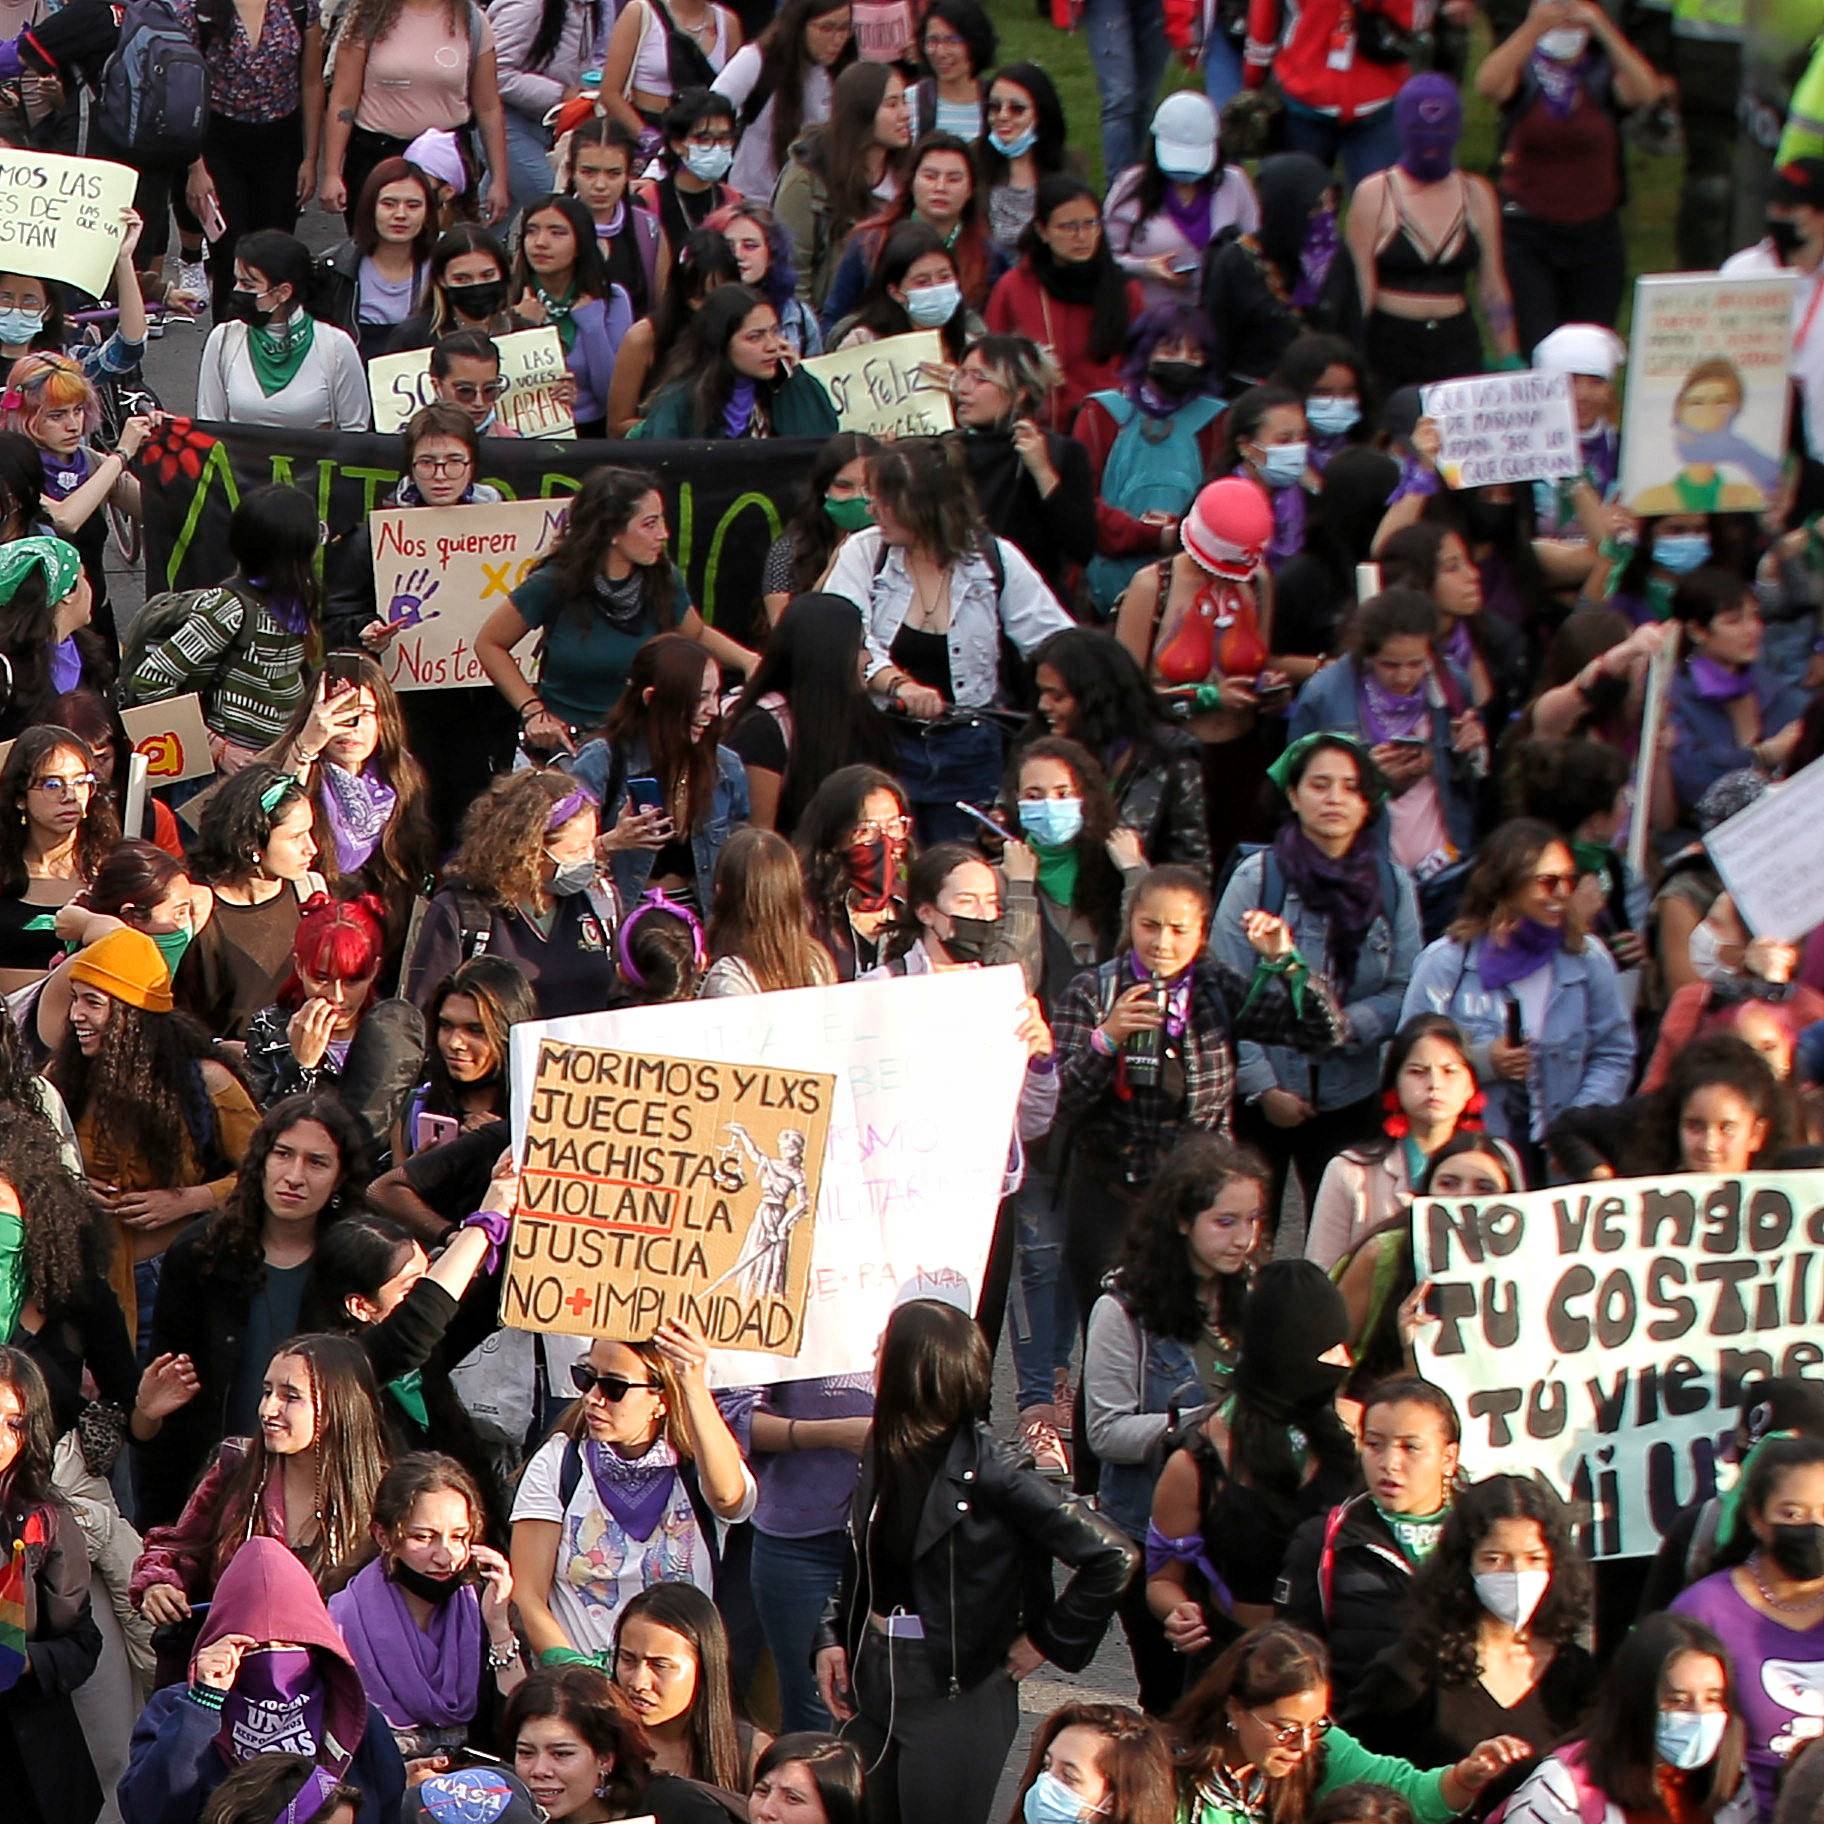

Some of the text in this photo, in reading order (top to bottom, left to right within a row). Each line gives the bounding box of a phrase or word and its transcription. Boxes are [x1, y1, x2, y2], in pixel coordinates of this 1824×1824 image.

[29, 194, 63, 221] DE
[57, 168, 104, 201] LAS
[516, 372, 557, 389] VOCES
[523, 348, 554, 370] LAS
[376, 519, 518, 571] Nos quieren
[390, 637, 446, 684] Nos
[538, 1046, 720, 1104] MORIMOS
[530, 1087, 693, 1143] JUECES
[523, 1134, 743, 1194] MACHISTAS
[522, 1175, 734, 1235] VIOLAN LA
[514, 1230, 710, 1279] JUSTICIA
[1427, 1279, 1523, 1358] TU
[430, 1777, 502, 1811] NASA
